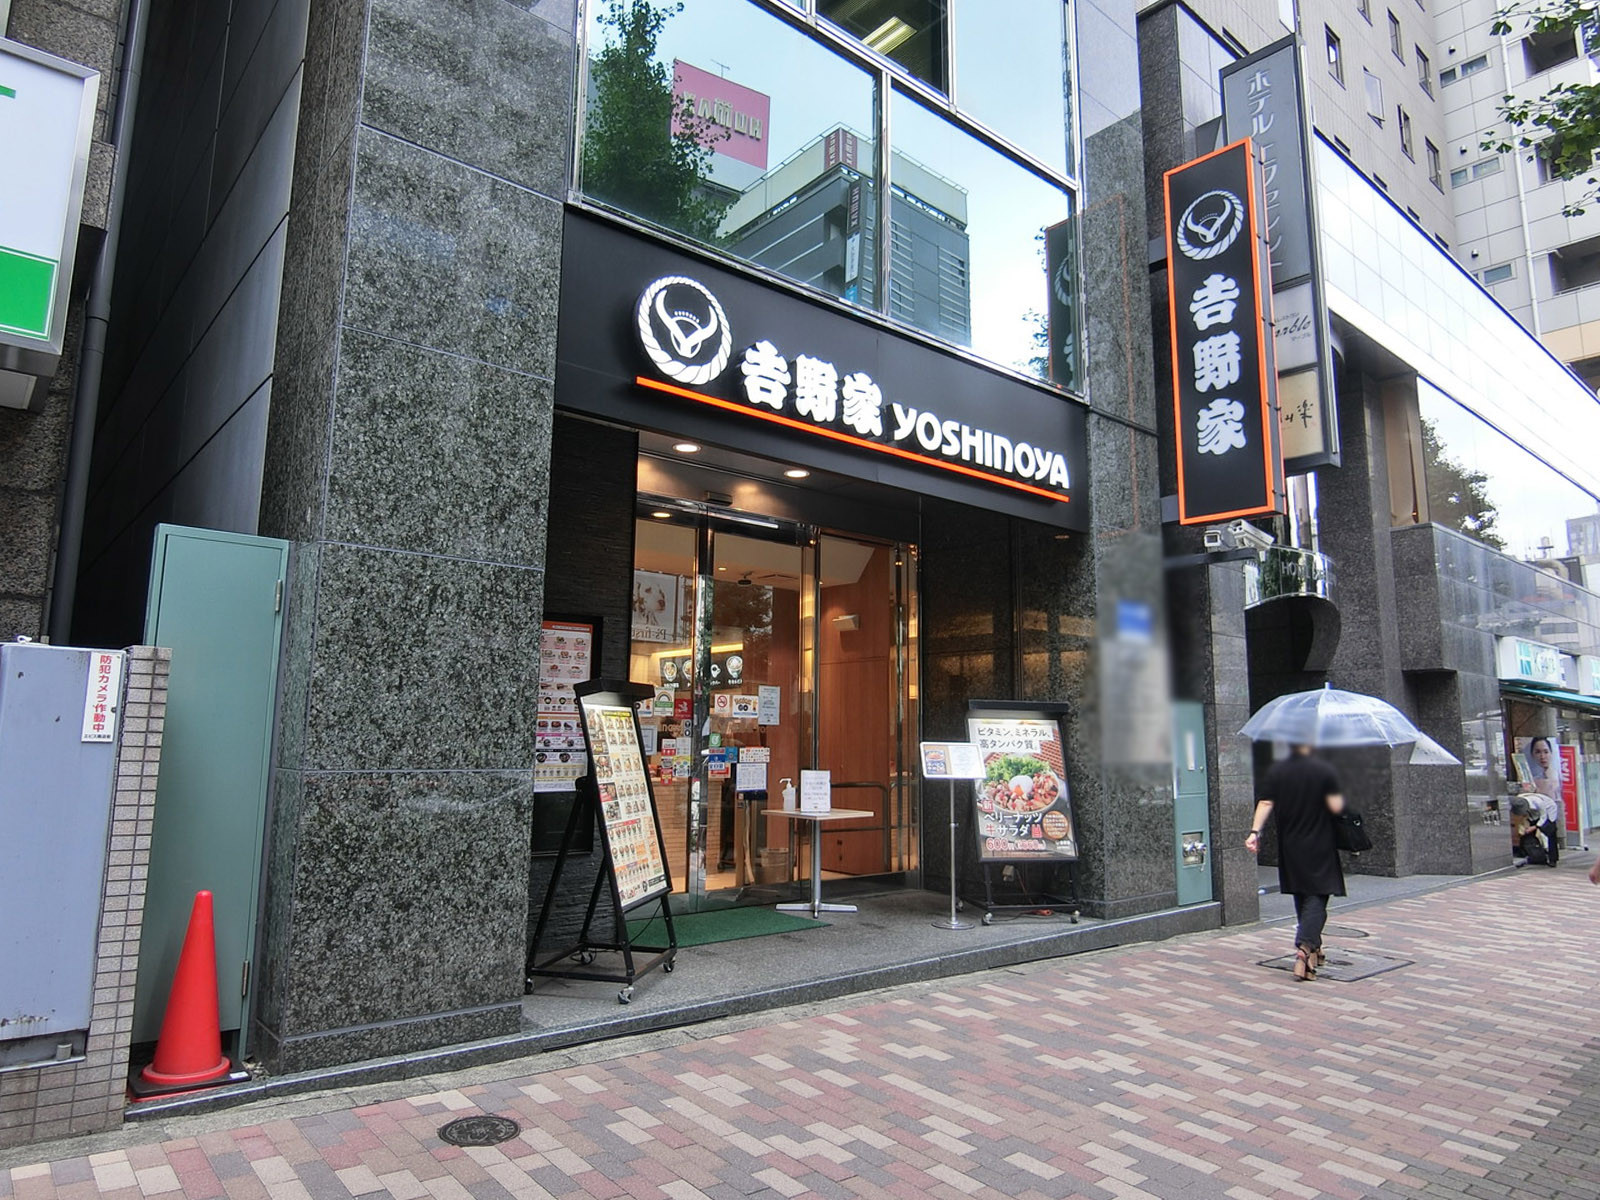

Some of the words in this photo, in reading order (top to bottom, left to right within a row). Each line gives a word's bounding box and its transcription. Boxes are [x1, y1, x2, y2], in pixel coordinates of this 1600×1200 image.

[741, 339, 883, 437] 吉野家
[892, 402, 1070, 489] YOSHINOYA
[1189, 273, 1247, 456] 吉野家
[92, 655, 113, 733] 防犯カメラ作動中
[977, 726, 1052, 738] ビタミン、ミネラル、
